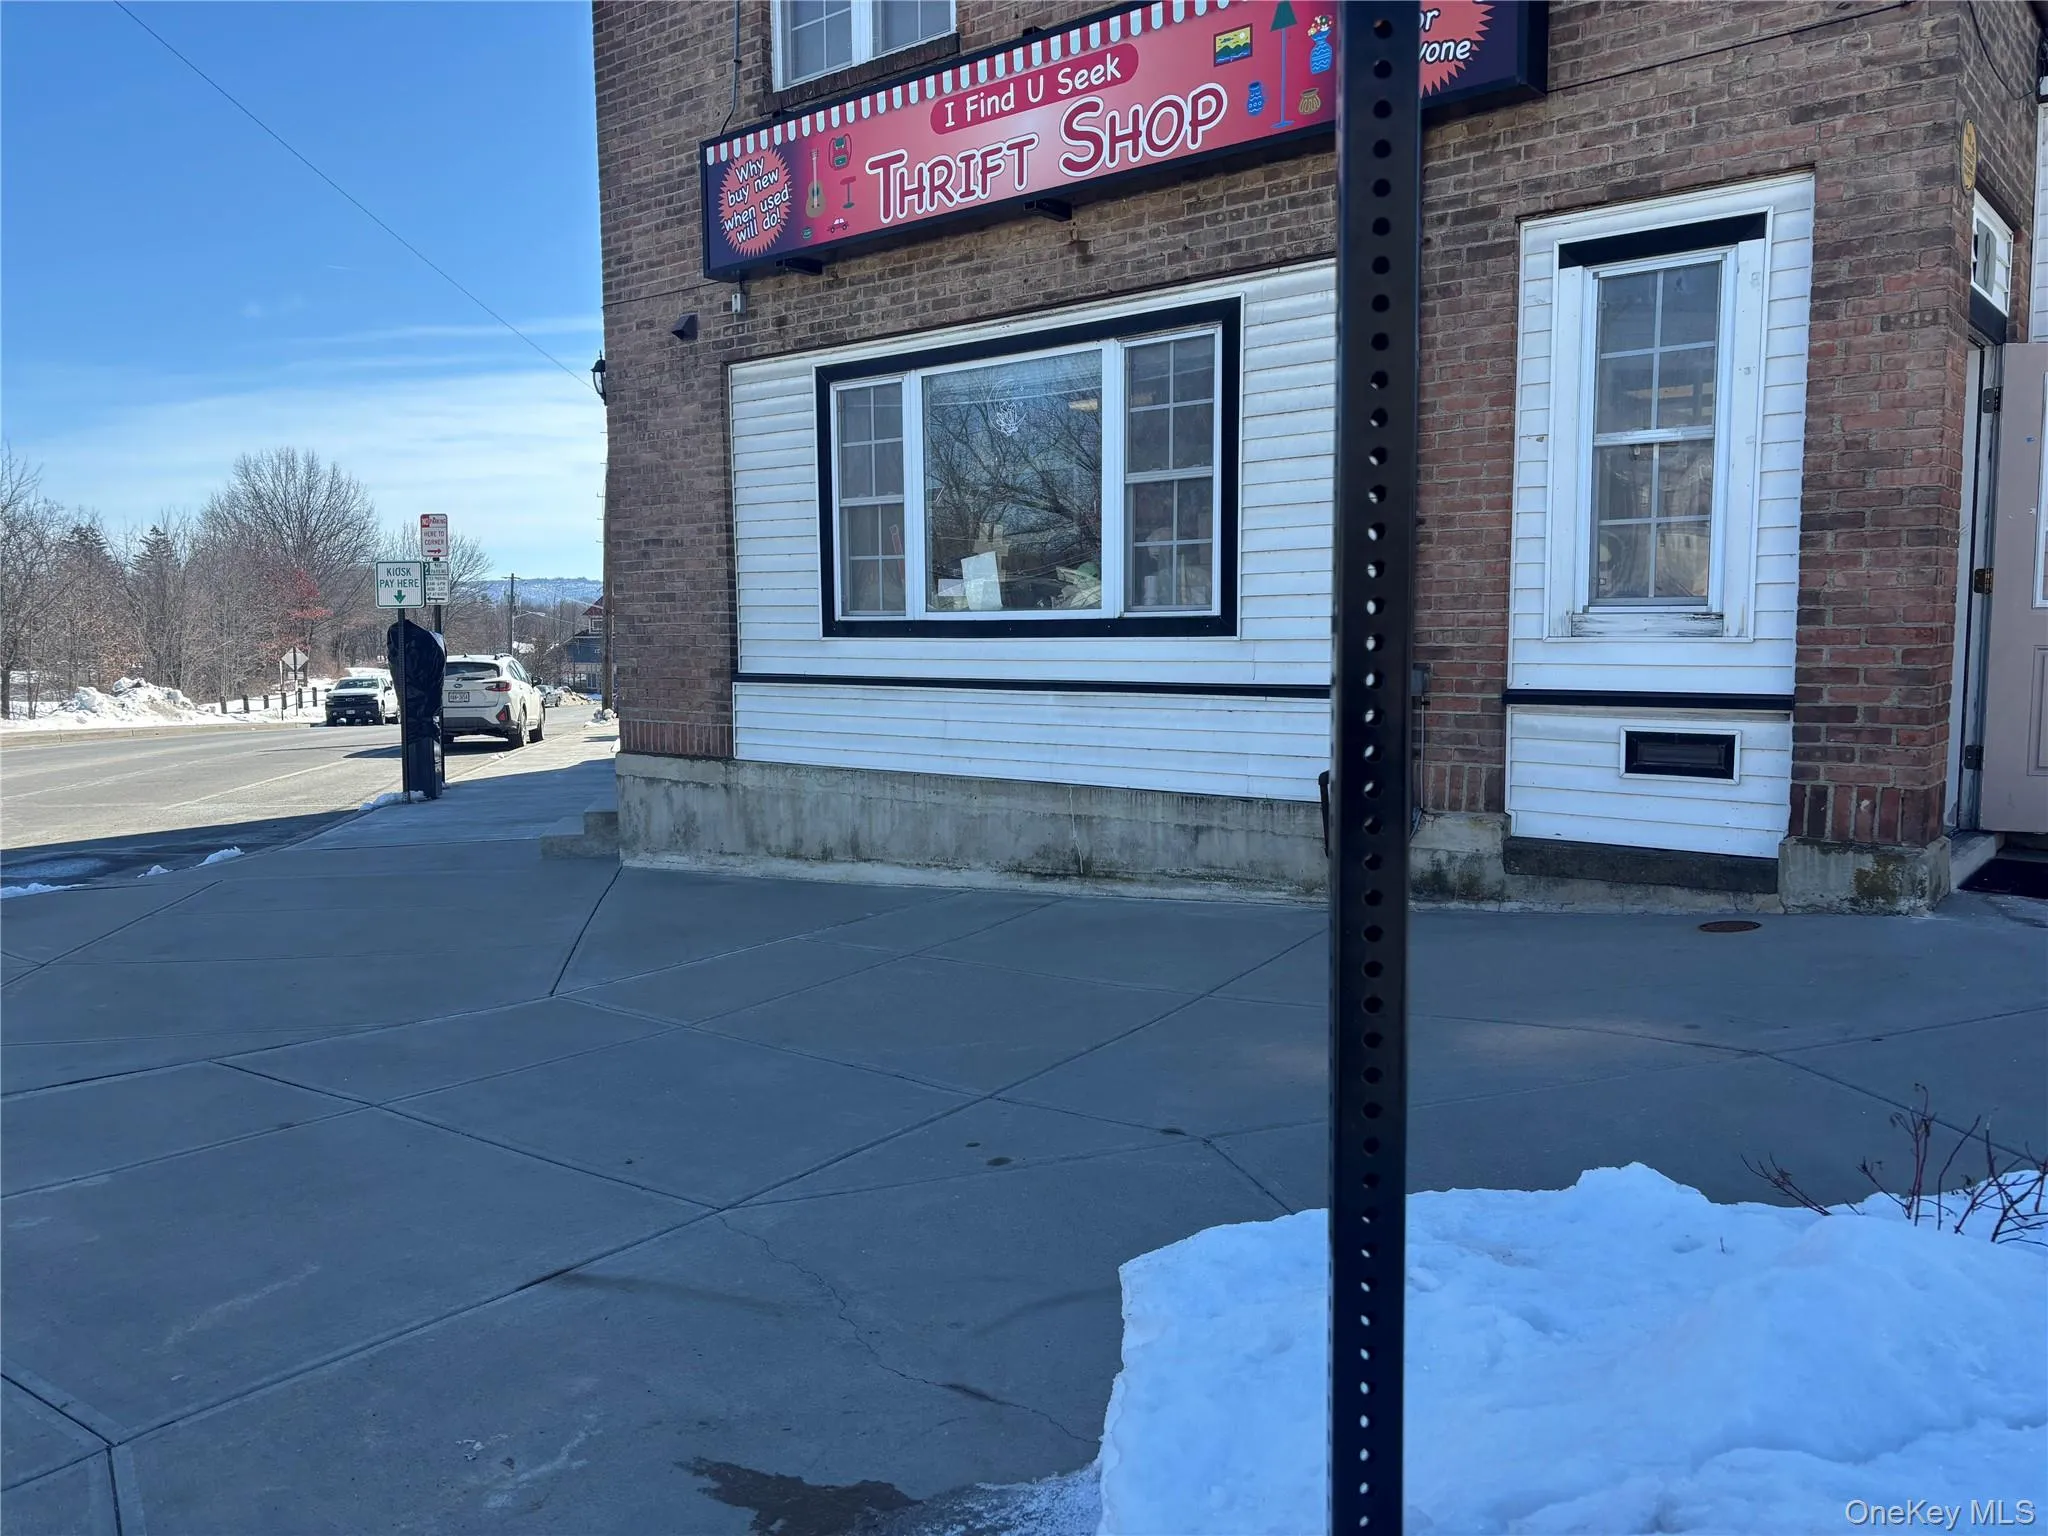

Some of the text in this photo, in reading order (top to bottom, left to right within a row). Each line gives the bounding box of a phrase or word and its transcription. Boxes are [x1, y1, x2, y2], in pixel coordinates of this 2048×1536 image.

[944, 52, 1122, 128] I Find U Seek
[735, 157, 765, 183] Why
[865, 82, 1229, 224] THRIFT SHOP
[727, 168, 779, 205] buy new
[724, 183, 790, 232] when used
[736, 207, 782, 244] will do!
[380, 579, 420, 588] PAY HERE
[386, 567, 411, 577] KIOSK
